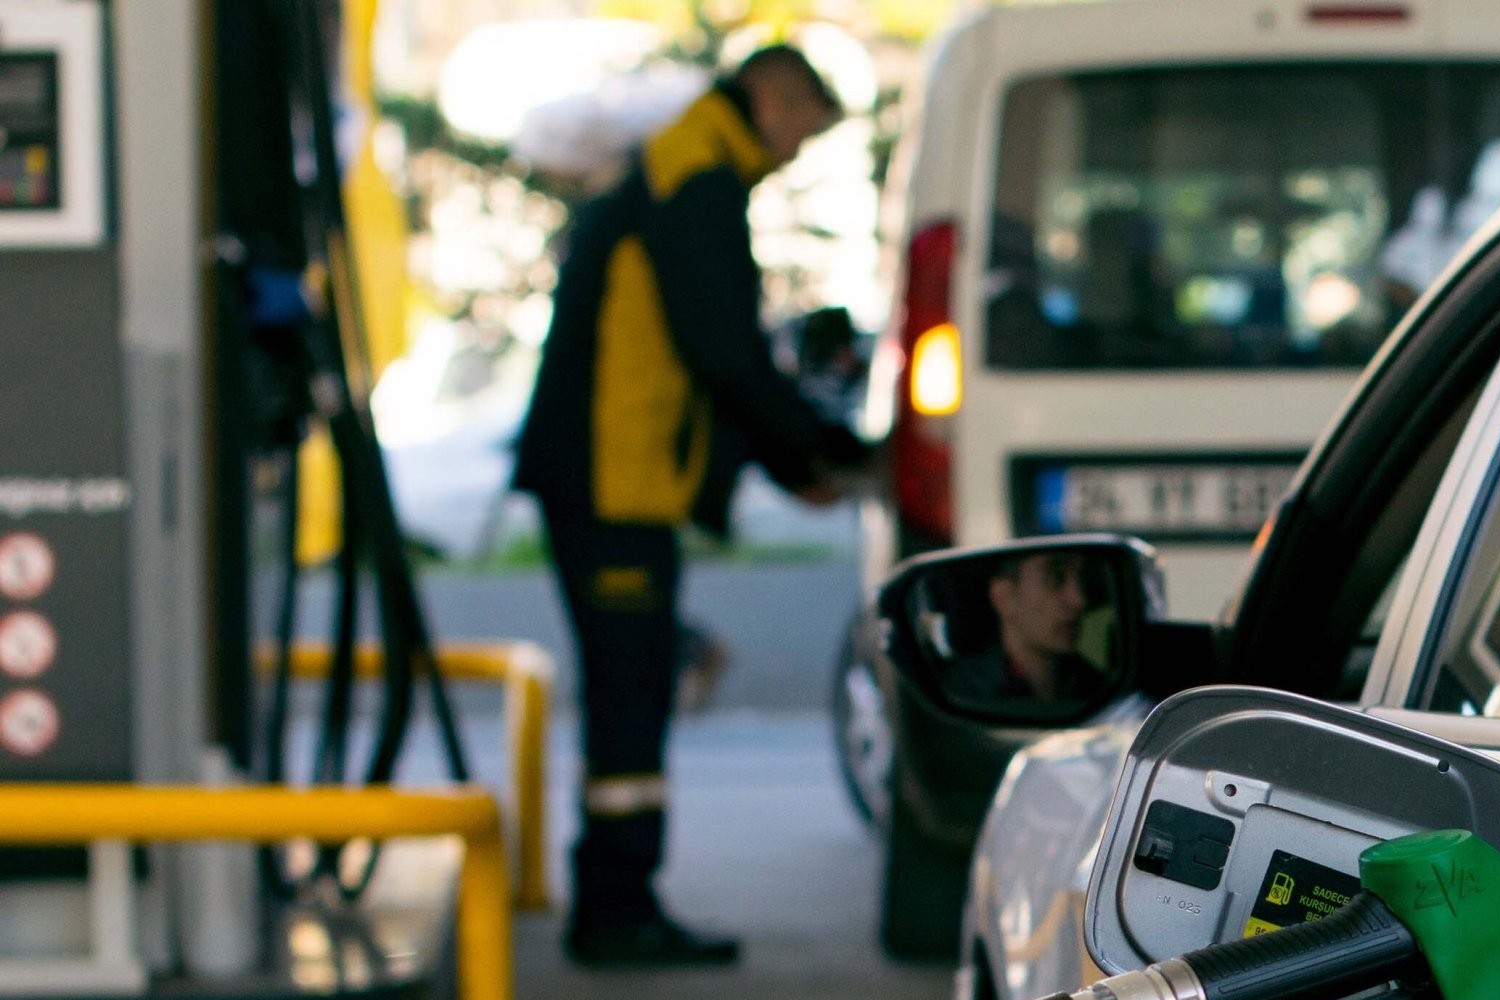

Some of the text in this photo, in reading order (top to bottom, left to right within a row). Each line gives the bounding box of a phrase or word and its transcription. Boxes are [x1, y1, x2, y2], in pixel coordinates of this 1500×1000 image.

[1299, 895, 1337, 915] KURŞUN
[1312, 885, 1351, 906] SADECE
[1305, 911, 1322, 922] BE
